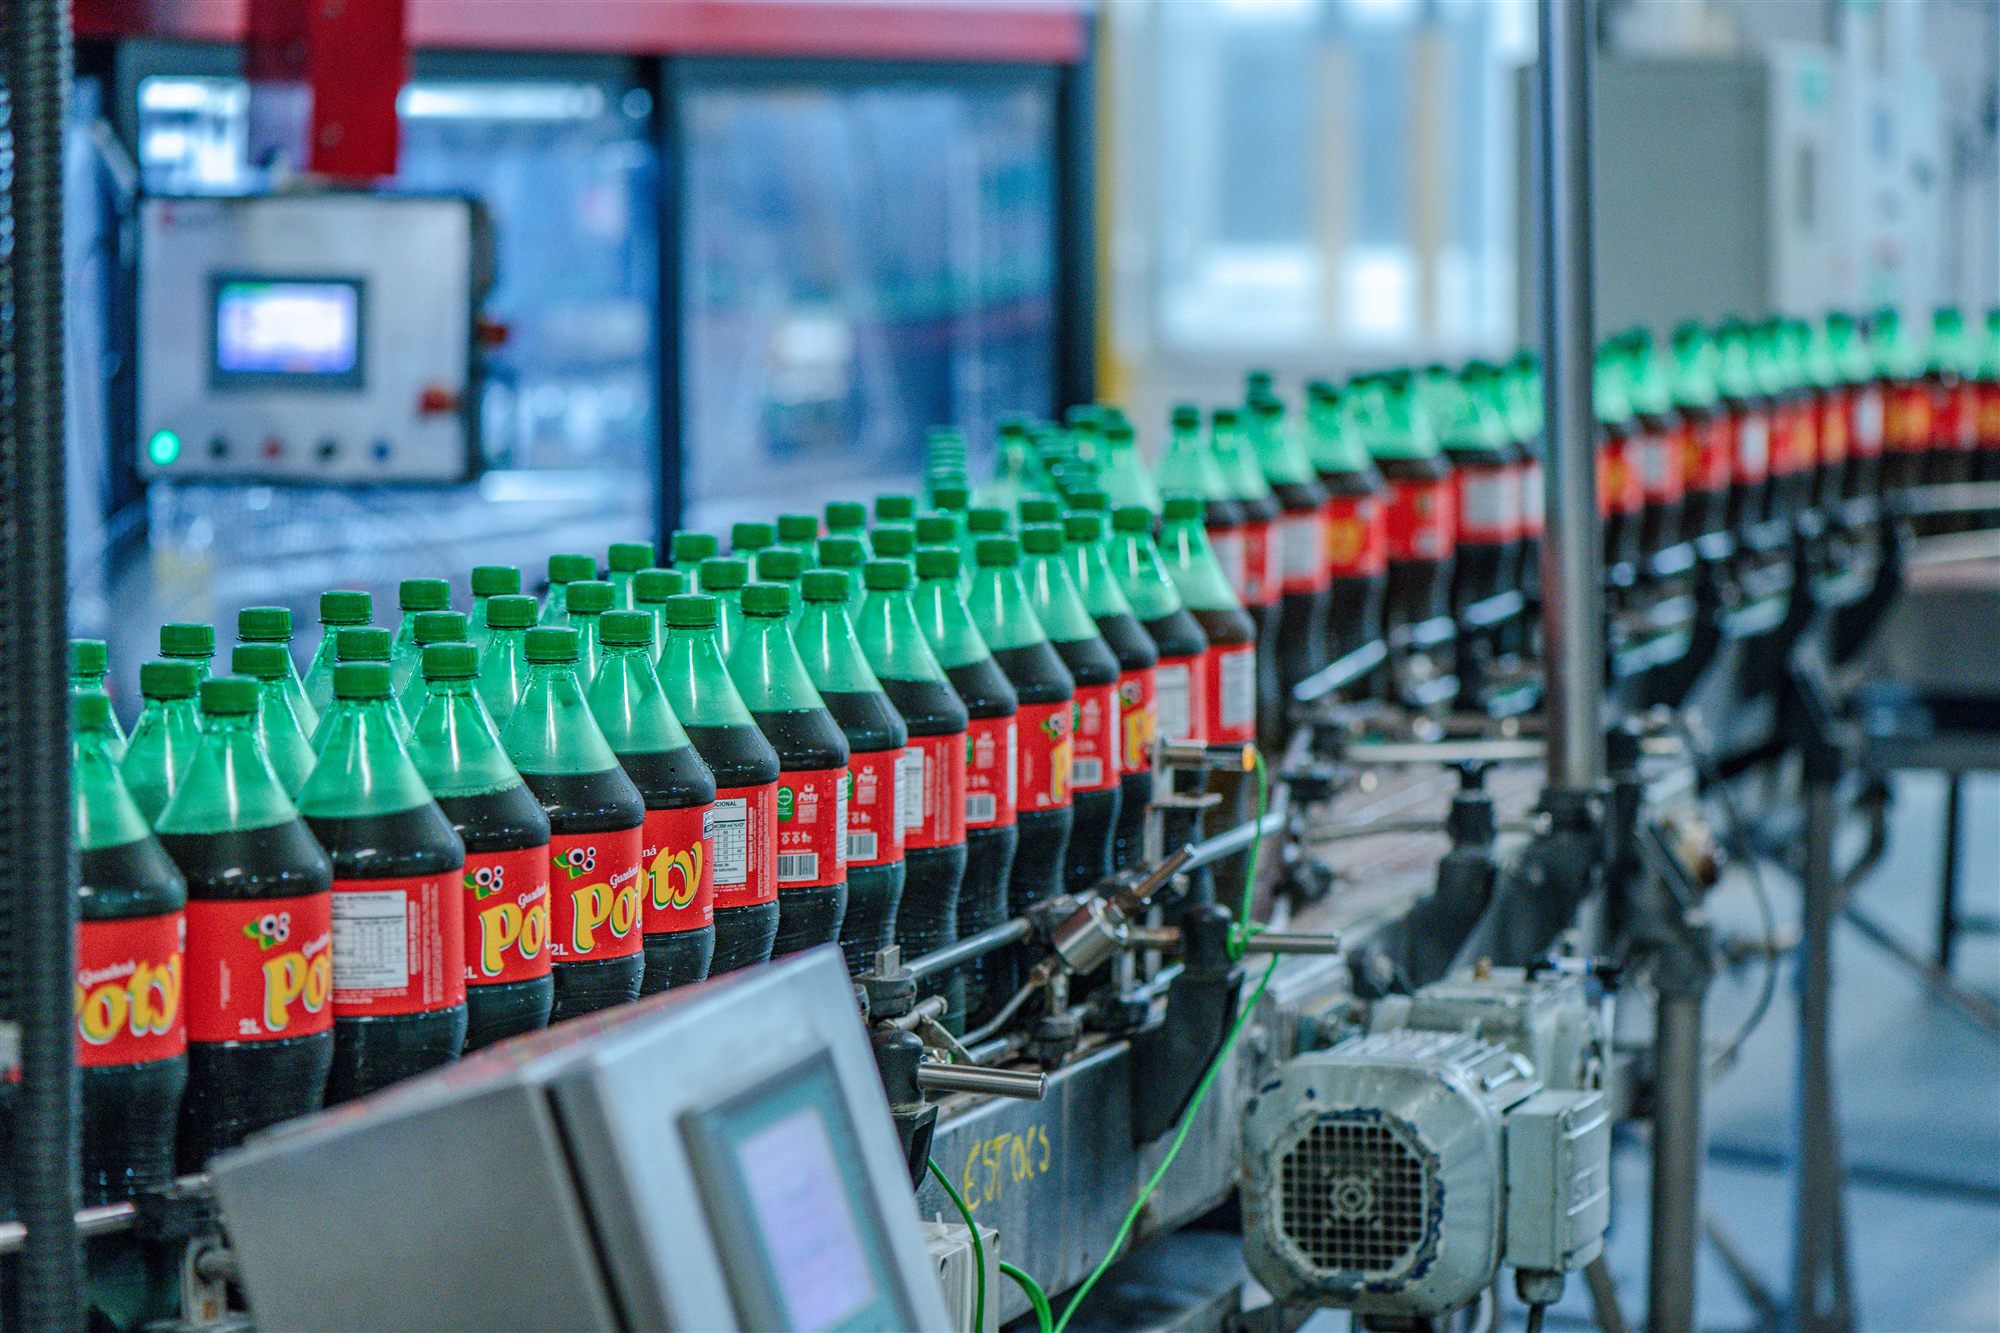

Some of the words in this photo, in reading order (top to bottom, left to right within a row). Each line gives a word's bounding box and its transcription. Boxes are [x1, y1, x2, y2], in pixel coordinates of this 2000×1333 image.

[262, 938, 332, 1032] Po
[551, 943, 568, 956] 2L
[74, 952, 181, 1046] oty
